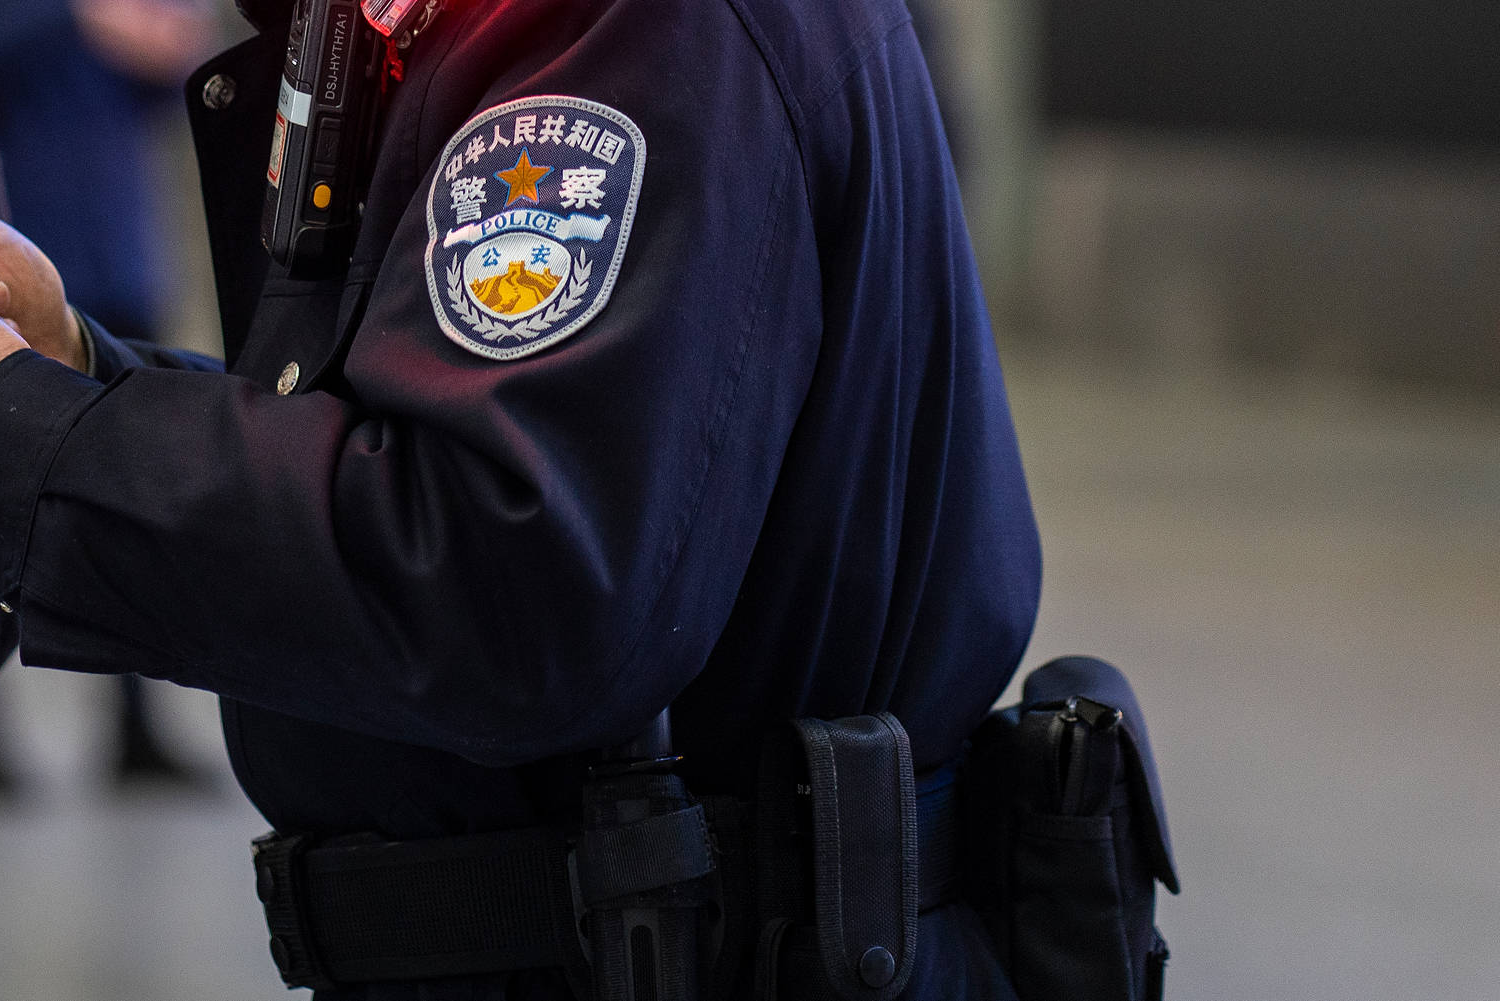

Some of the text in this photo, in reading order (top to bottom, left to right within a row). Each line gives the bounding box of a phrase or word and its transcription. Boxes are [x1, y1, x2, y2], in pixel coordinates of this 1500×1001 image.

[324, 13, 348, 100] DSJ-HYTH7A1
[444, 114, 627, 182] 中华人民共和国
[480, 210, 563, 237] POLICE
